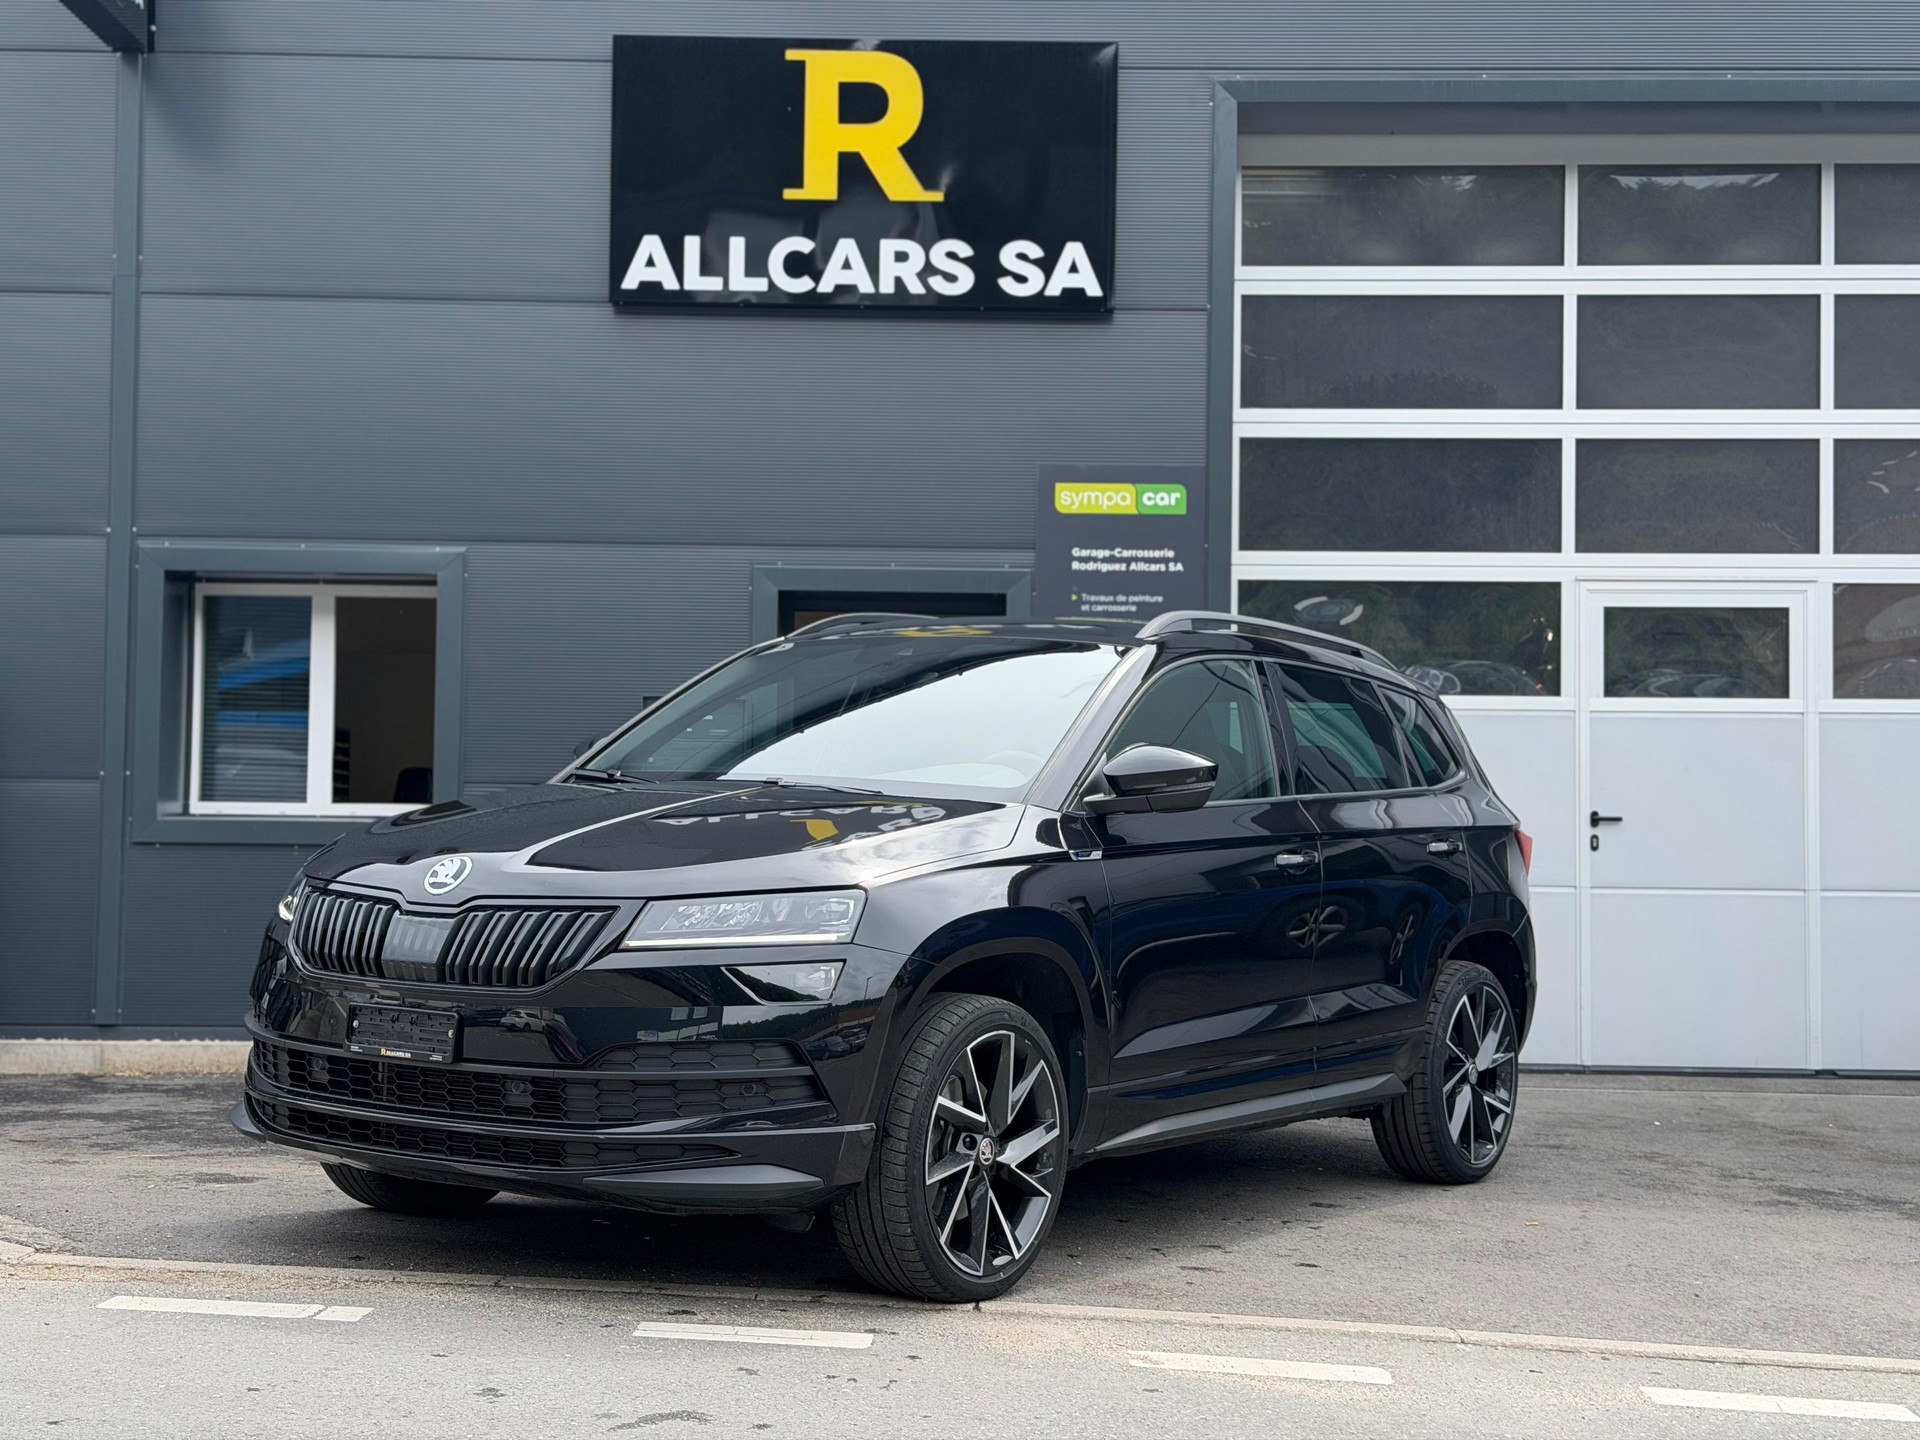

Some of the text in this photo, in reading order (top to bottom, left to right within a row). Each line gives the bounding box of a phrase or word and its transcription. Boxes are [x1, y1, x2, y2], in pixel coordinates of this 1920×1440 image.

[782, 48, 945, 203] R
[620, 233, 1105, 298] ALLCARS SA
[1060, 490, 1181, 510] sympa car
[1071, 547, 1175, 559] Garage-Carrosserie
[1071, 561, 1184, 573] Rodriguez Allcars SA
[1081, 593, 1164, 603] Travaux de peinture
[1081, 603, 1137, 612] et carrosserie
